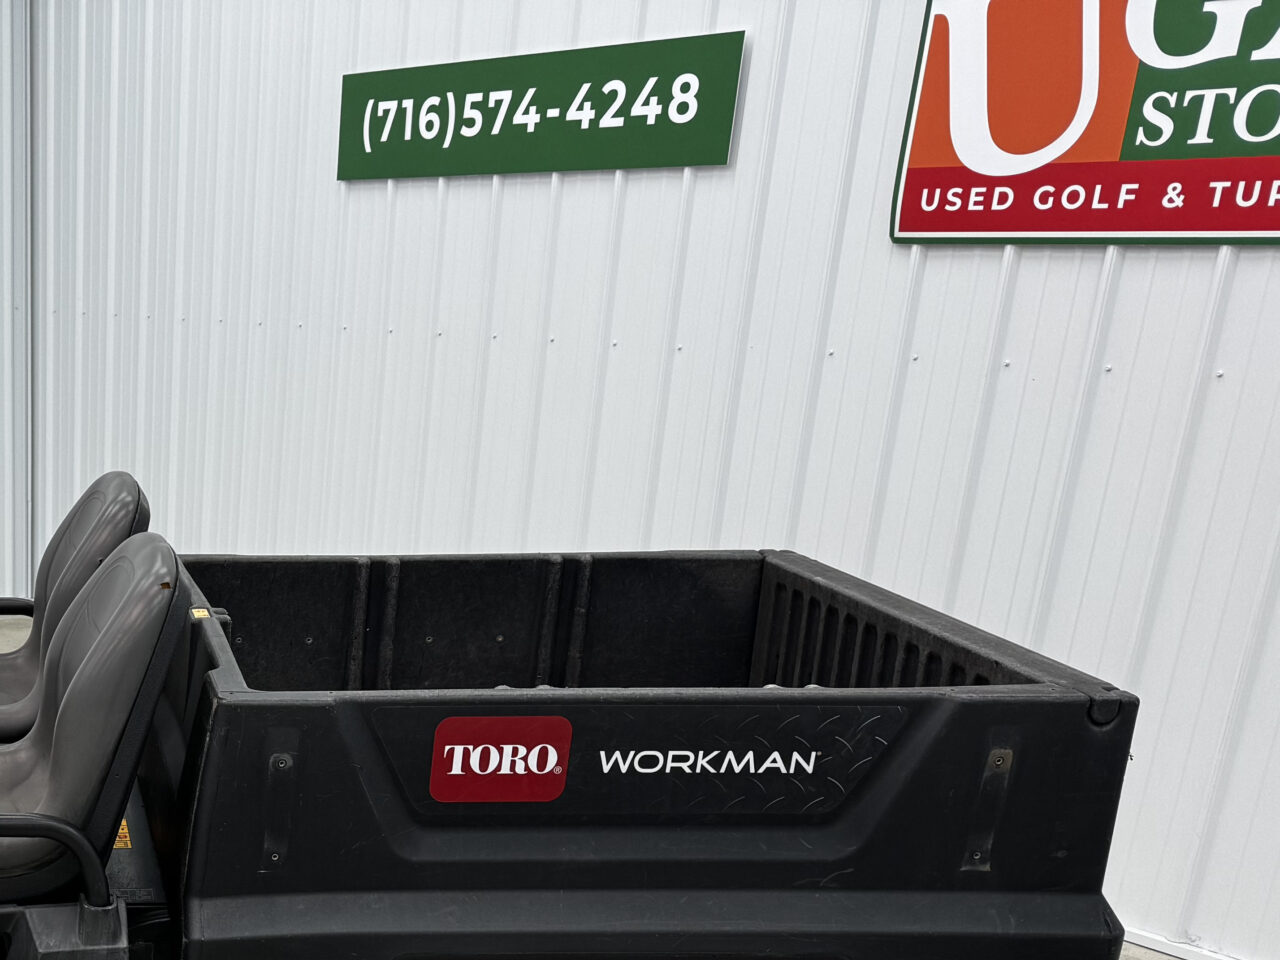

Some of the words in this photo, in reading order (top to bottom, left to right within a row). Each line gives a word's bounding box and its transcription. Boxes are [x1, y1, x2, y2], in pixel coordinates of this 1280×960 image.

[362, 73, 700, 153] (716)574-4248
[920, 187, 1015, 212] USED
[1032, 183, 1139, 210] GOLF
[1161, 182, 1185, 208] &
[444, 744, 559, 775] TORO
[599, 750, 817, 774] WORKMAN
